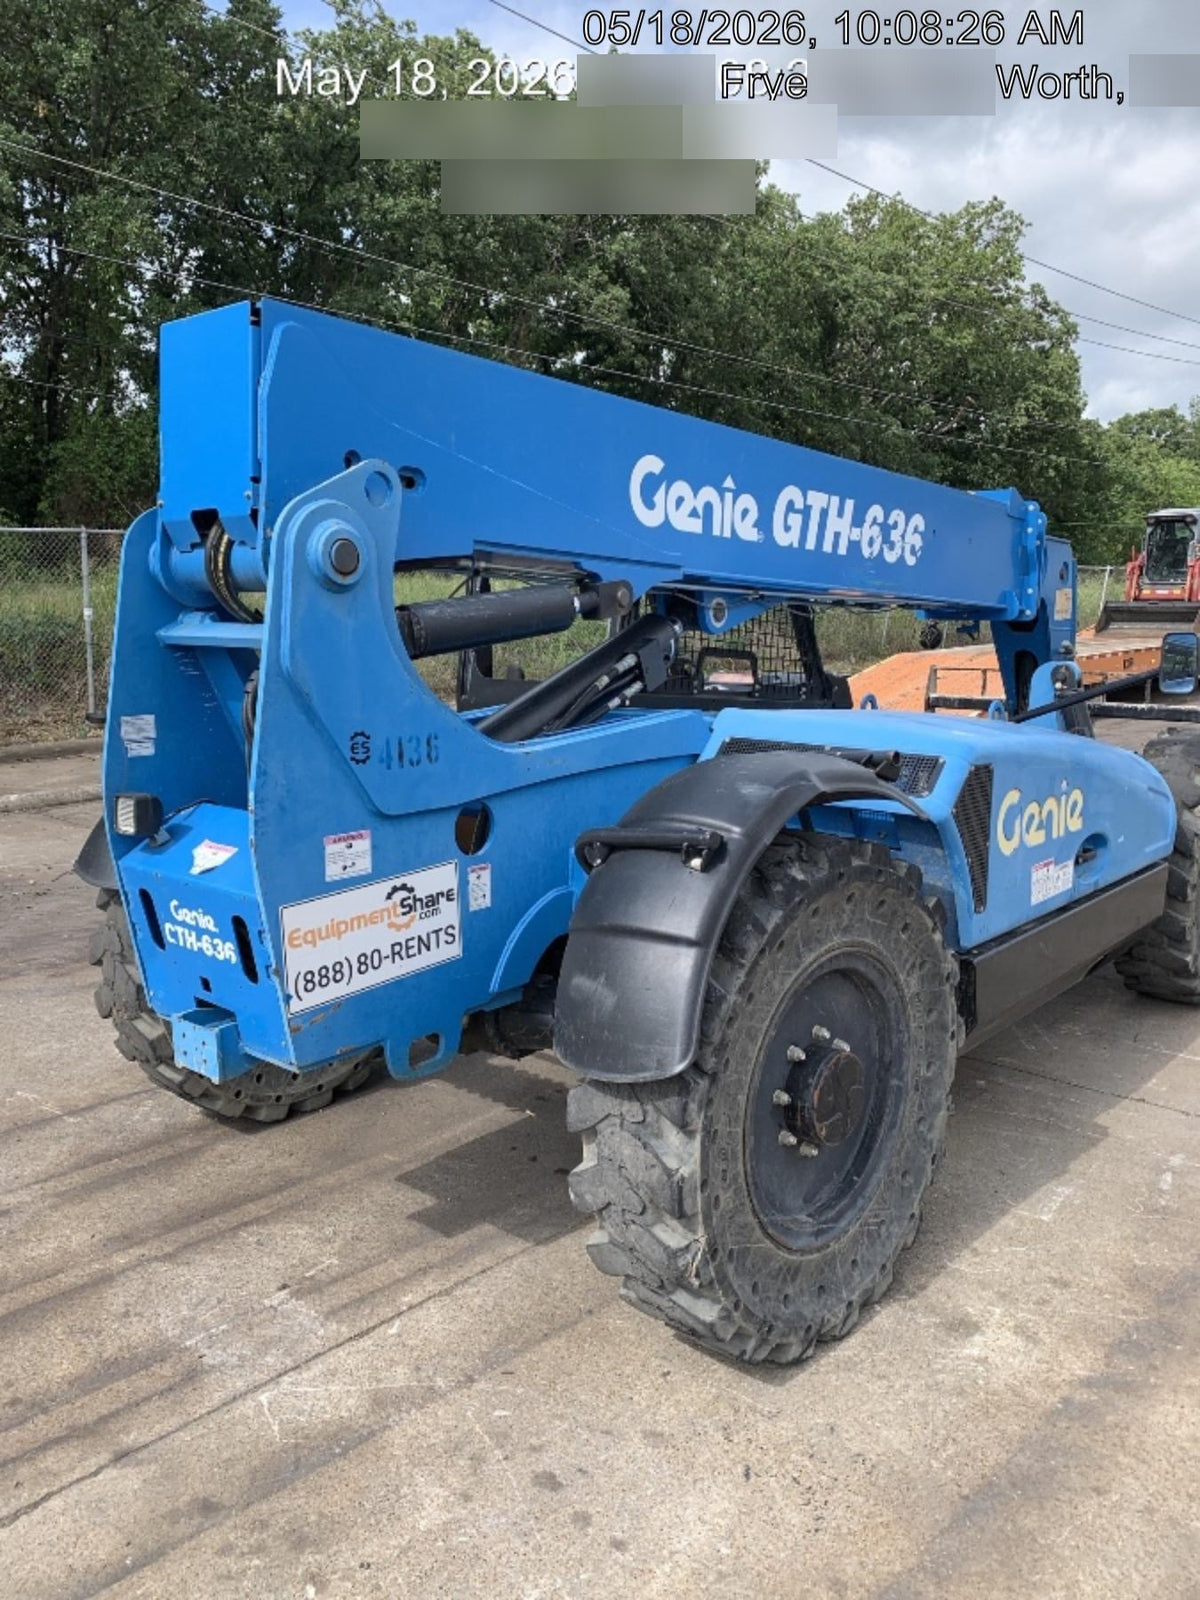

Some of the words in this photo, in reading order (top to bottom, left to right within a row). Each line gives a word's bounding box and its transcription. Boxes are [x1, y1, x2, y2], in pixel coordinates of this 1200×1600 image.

[629, 454, 760, 542] Genie
[773, 484, 925, 566] GTH-636
[997, 779, 1084, 856] Genie
[170, 899, 219, 932] Genie
[287, 887, 456, 950] EquipmentShare
[294, 956, 353, 1002] (888)
[356, 924, 457, 976] 80-RENTS
